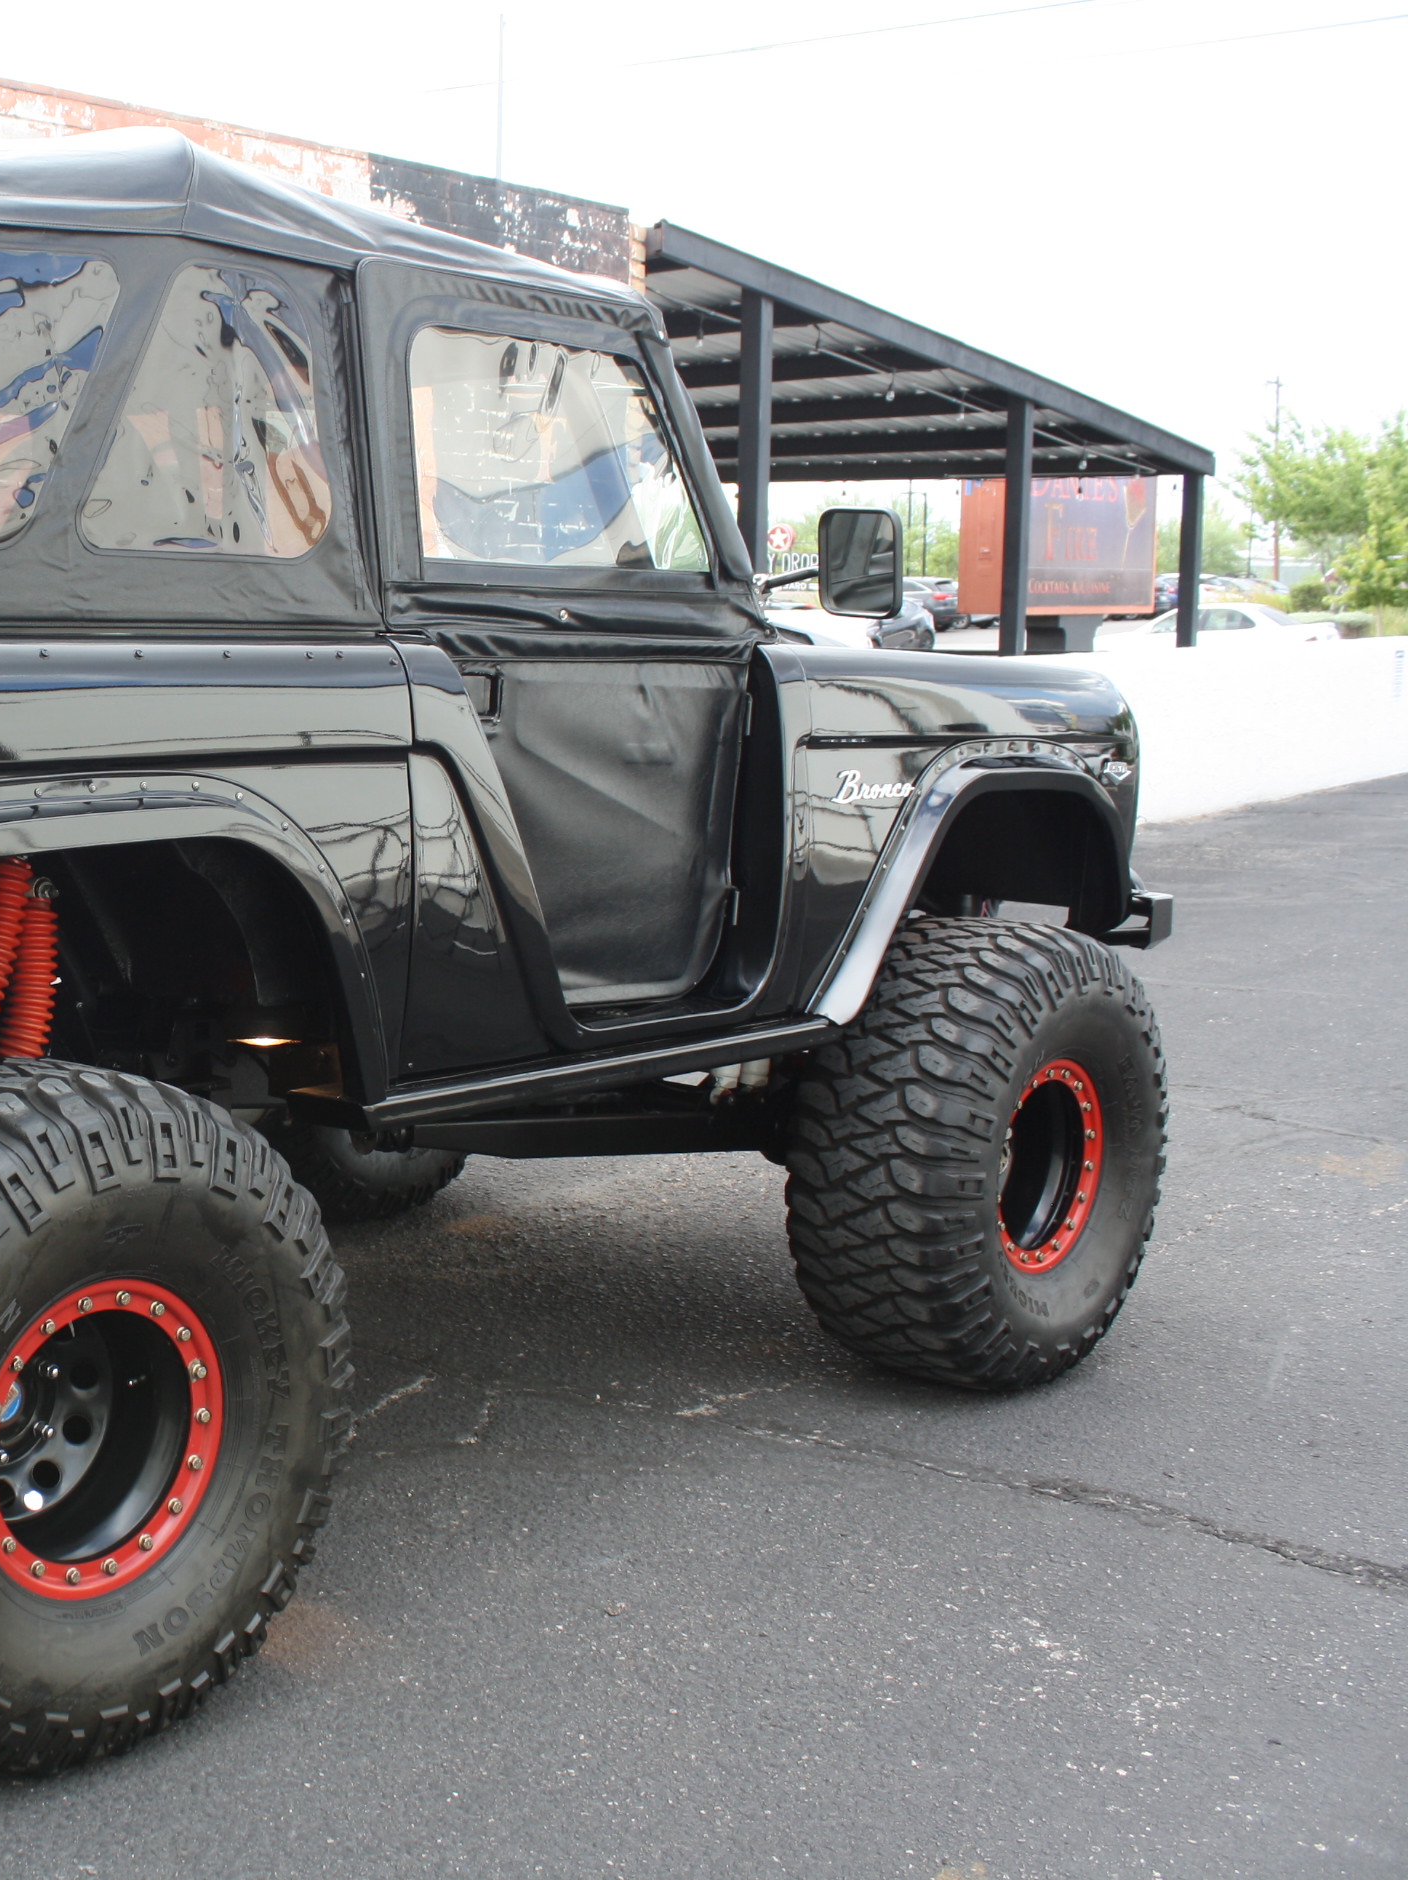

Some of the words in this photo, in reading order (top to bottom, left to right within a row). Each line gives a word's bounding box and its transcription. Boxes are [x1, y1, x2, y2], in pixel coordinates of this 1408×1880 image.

[1044, 503, 1098, 561] FIRE
[830, 769, 915, 804] Bronco
[208, 1246, 290, 1400] MICKEY
[133, 1424, 291, 1656] THOMPSON
